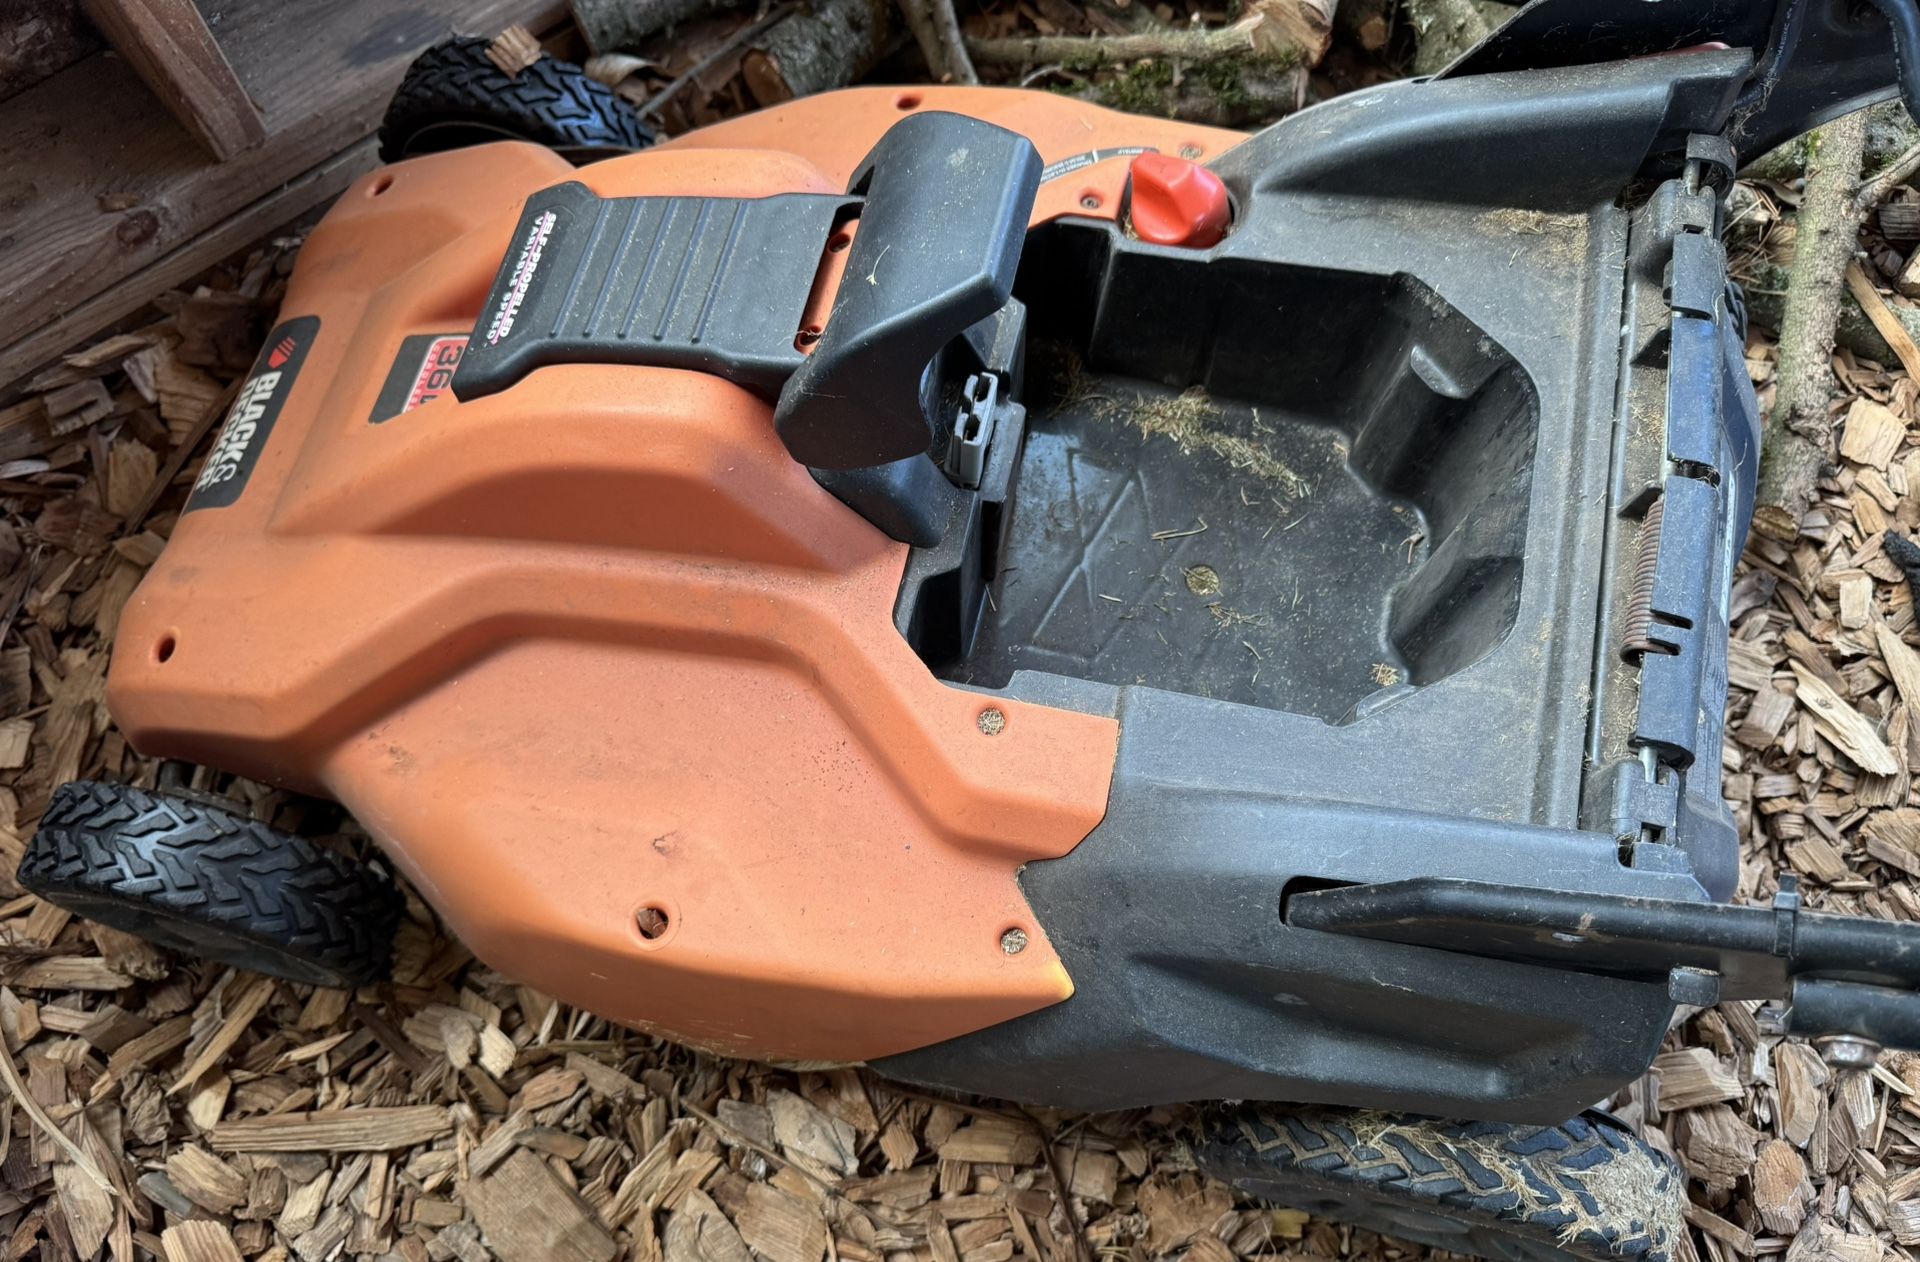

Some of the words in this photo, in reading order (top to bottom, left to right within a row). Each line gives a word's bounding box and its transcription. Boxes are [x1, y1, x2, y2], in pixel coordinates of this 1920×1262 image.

[499, 213, 557, 338] SELF-PROPELLED
[508, 216, 545, 288] VARIABLE
[486, 292, 513, 340] SPEED
